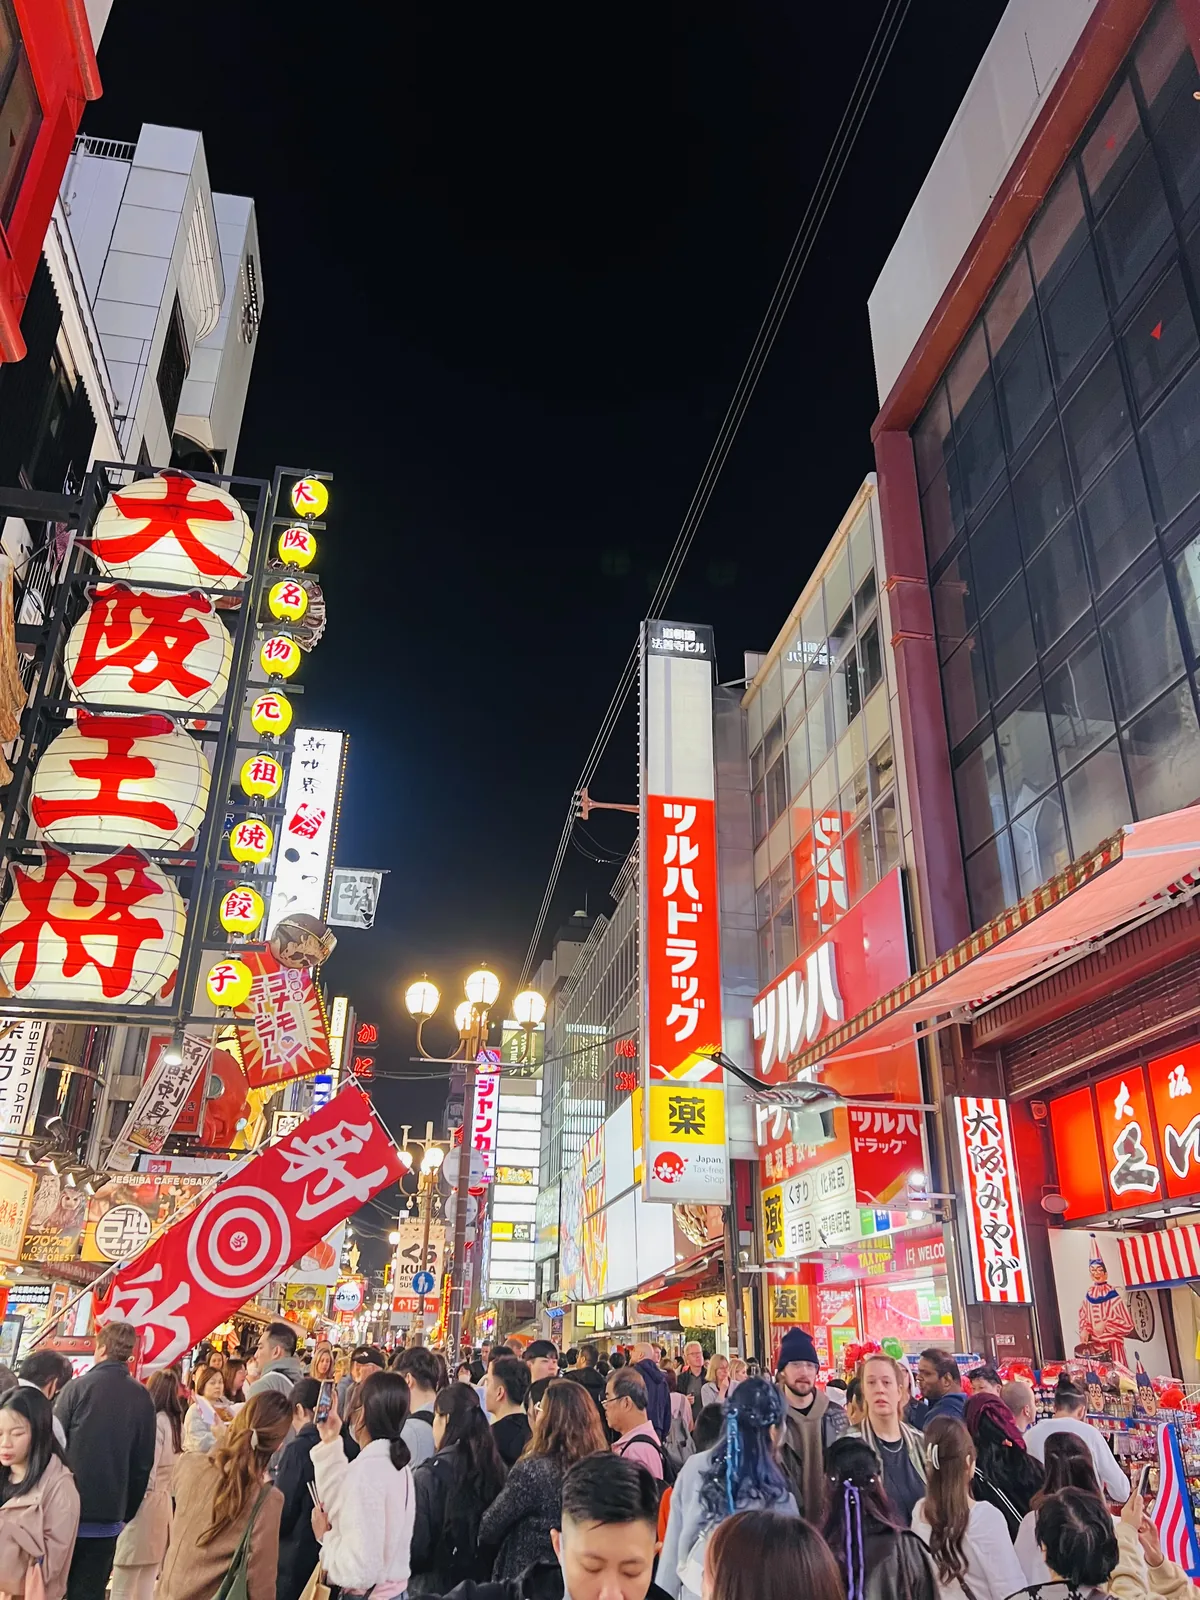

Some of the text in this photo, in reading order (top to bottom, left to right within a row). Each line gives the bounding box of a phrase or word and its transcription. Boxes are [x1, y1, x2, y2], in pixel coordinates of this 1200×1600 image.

[652, 638, 707, 654] 法善寺ビル
[0, 471, 252, 1004] 大阪王将
[208, 480, 316, 1000] 大阪名物元祖焼餃子
[661, 802, 705, 1043] ツルハドラッグ
[250, 977, 283, 1066] ミュージアム
[268, 973, 303, 1060] コナモン
[752, 941, 844, 1075] ツルハ
[9, 1020, 42, 1124] ESHIBA CAFE
[147, 1036, 204, 1124] 新鮮刺身
[1113, 1063, 1193, 1121] 大阪
[668, 1095, 706, 1136] 薬
[850, 1108, 920, 1136] ツルハ
[853, 1138, 908, 1154] ドラッグ
[95, 1174, 218, 1188] MESHIBA CAFE OSAKA
[692, 1165, 724, 1175] Tax-free
[704, 1174, 725, 1185] Shop
[820, 1165, 846, 1195] 化粧品
[788, 1180, 809, 1205] くすり
[964, 1106, 1023, 1292] 大阪みやげ
[764, 1194, 783, 1249] 薬
[791, 1220, 813, 1245] 日用品
[20, 1252, 76, 1262] WLS FOREST
[30, 1245, 60, 1254] OSAKA
[401, 1242, 438, 1264] くら
[858, 1252, 874, 1269] TAX
[917, 1242, 945, 1263] WELCO
[400, 1264, 437, 1275] KUA
[495, 1285, 522, 1295] ZAZA
[773, 1288, 798, 1319] 薬
